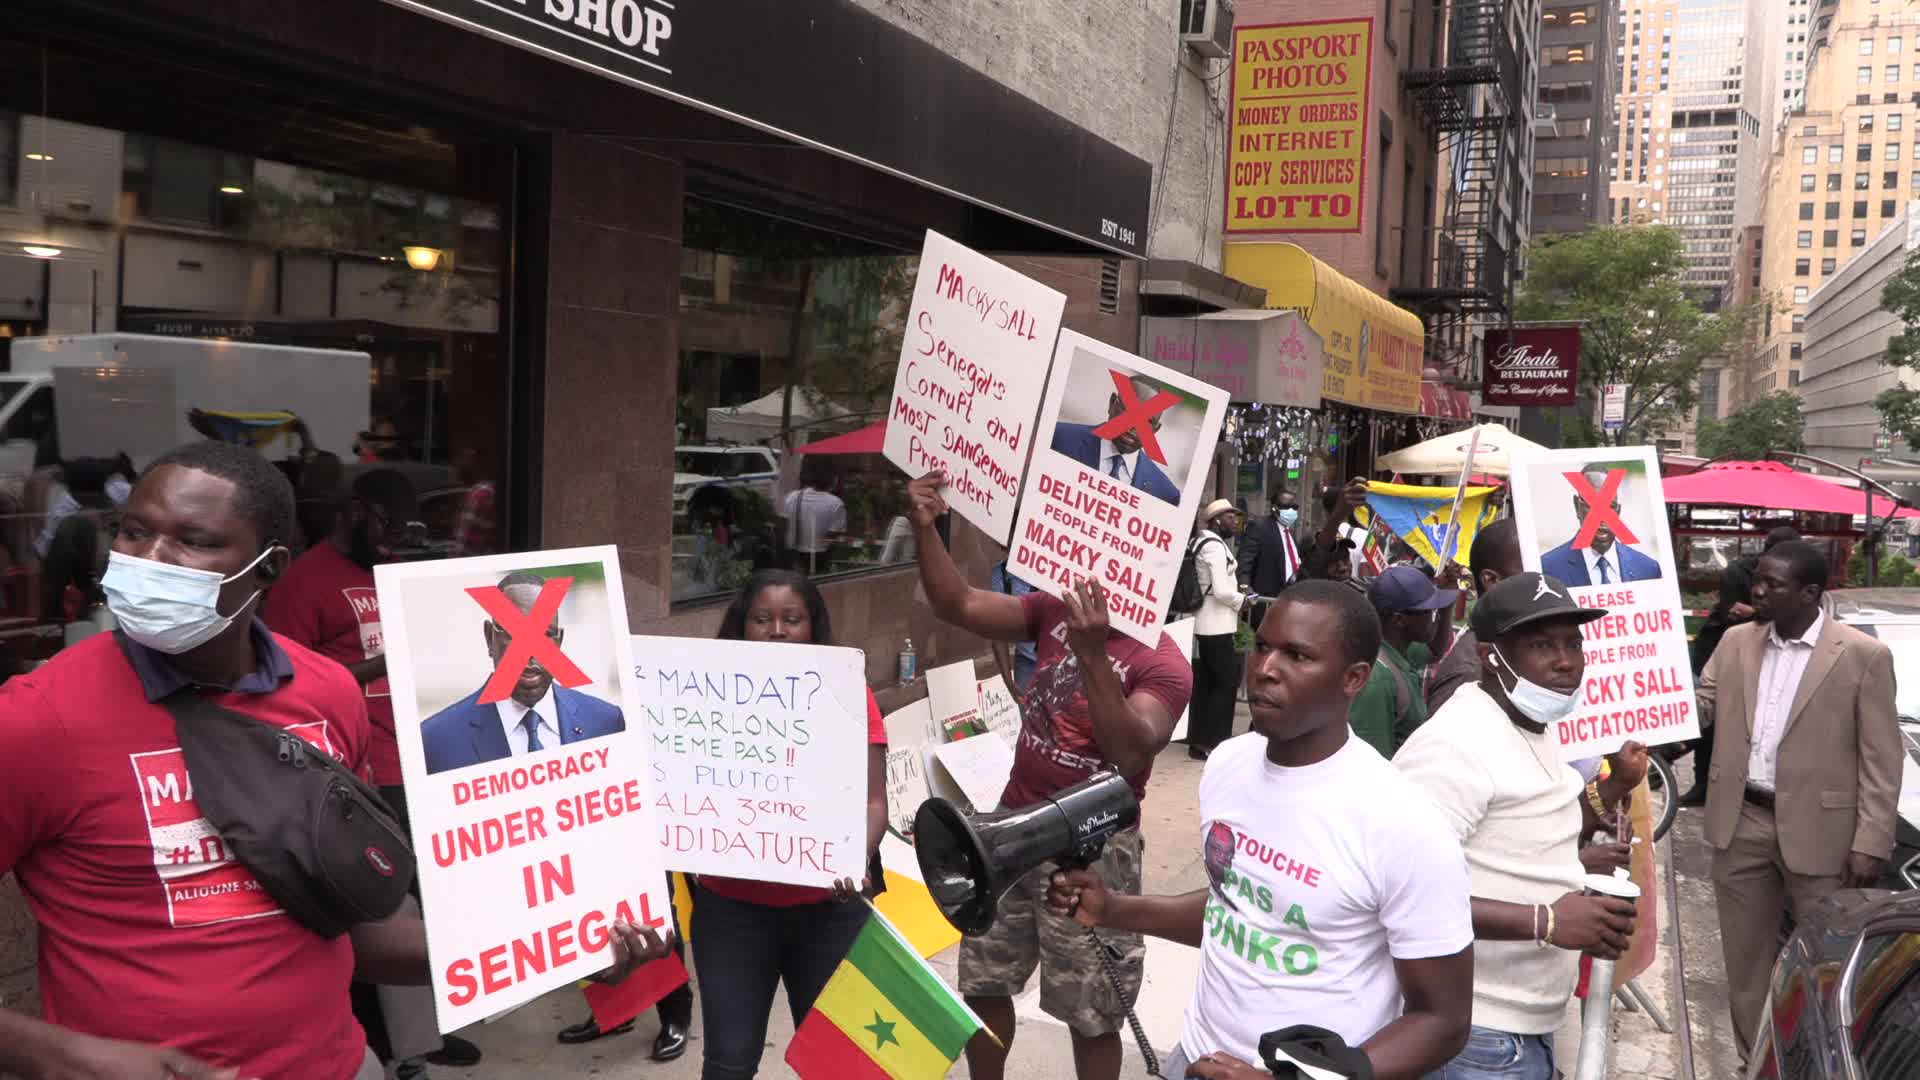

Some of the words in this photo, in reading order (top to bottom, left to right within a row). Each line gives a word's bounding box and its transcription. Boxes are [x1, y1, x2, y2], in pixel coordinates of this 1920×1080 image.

[1242, 33, 1361, 63] PASSPORT
[1252, 63, 1348, 90] PHOTOS
[1238, 105, 1291, 126] MONEY
[1300, 103, 1358, 123] ORDERS
[1239, 130, 1355, 152] INTERNET
[1234, 161, 1273, 187] COPY
[1280, 159, 1355, 185] SERVICES
[1234, 194, 1351, 219] LOTTO
[1101, 218, 1118, 239] EST
[1119, 227, 1136, 246] 1941
[936, 263, 998, 322] MACKY
[994, 299, 1036, 341] SALL
[917, 311, 1006, 401] Senegal's
[1489, 344, 1560, 369] Alcala
[1500, 369, 1569, 379] RESTAURANT
[906, 361, 974, 424] Corrupt
[987, 417, 1022, 451] and
[1078, 471, 1140, 510] PLEASE
[1039, 474, 1122, 529] DELIVER
[1127, 516, 1173, 553] OUR
[1044, 504, 1099, 540] PEOPLE
[1102, 531, 1144, 561] FROM
[1025, 519, 1102, 571] MACKY
[1105, 559, 1159, 604] SALL
[1578, 590, 1636, 610] PLEASE
[1634, 609, 1673, 635] OUR
[1619, 643, 1657, 663] FROM
[658, 669, 822, 711] MANDAT?
[1634, 666, 1684, 699] SALL
[673, 706, 811, 746] PARLONS
[1558, 701, 1690, 746] DICTATORSHIP
[651, 732, 723, 758] MEME
[452, 747, 610, 806] DEMOCRACY
[695, 765, 797, 793] PLUTOT
[684, 792, 721, 818] LA
[431, 806, 548, 869] UNDER
[555, 780, 642, 833] SIEGE
[1235, 831, 1322, 889] TOUCHE
[174, 880, 241, 902] ALIOUNE
[522, 853, 575, 910] IN
[1223, 866, 1273, 913] PAS
[1282, 903, 1310, 933] A
[445, 892, 665, 1008] SENEGAL
